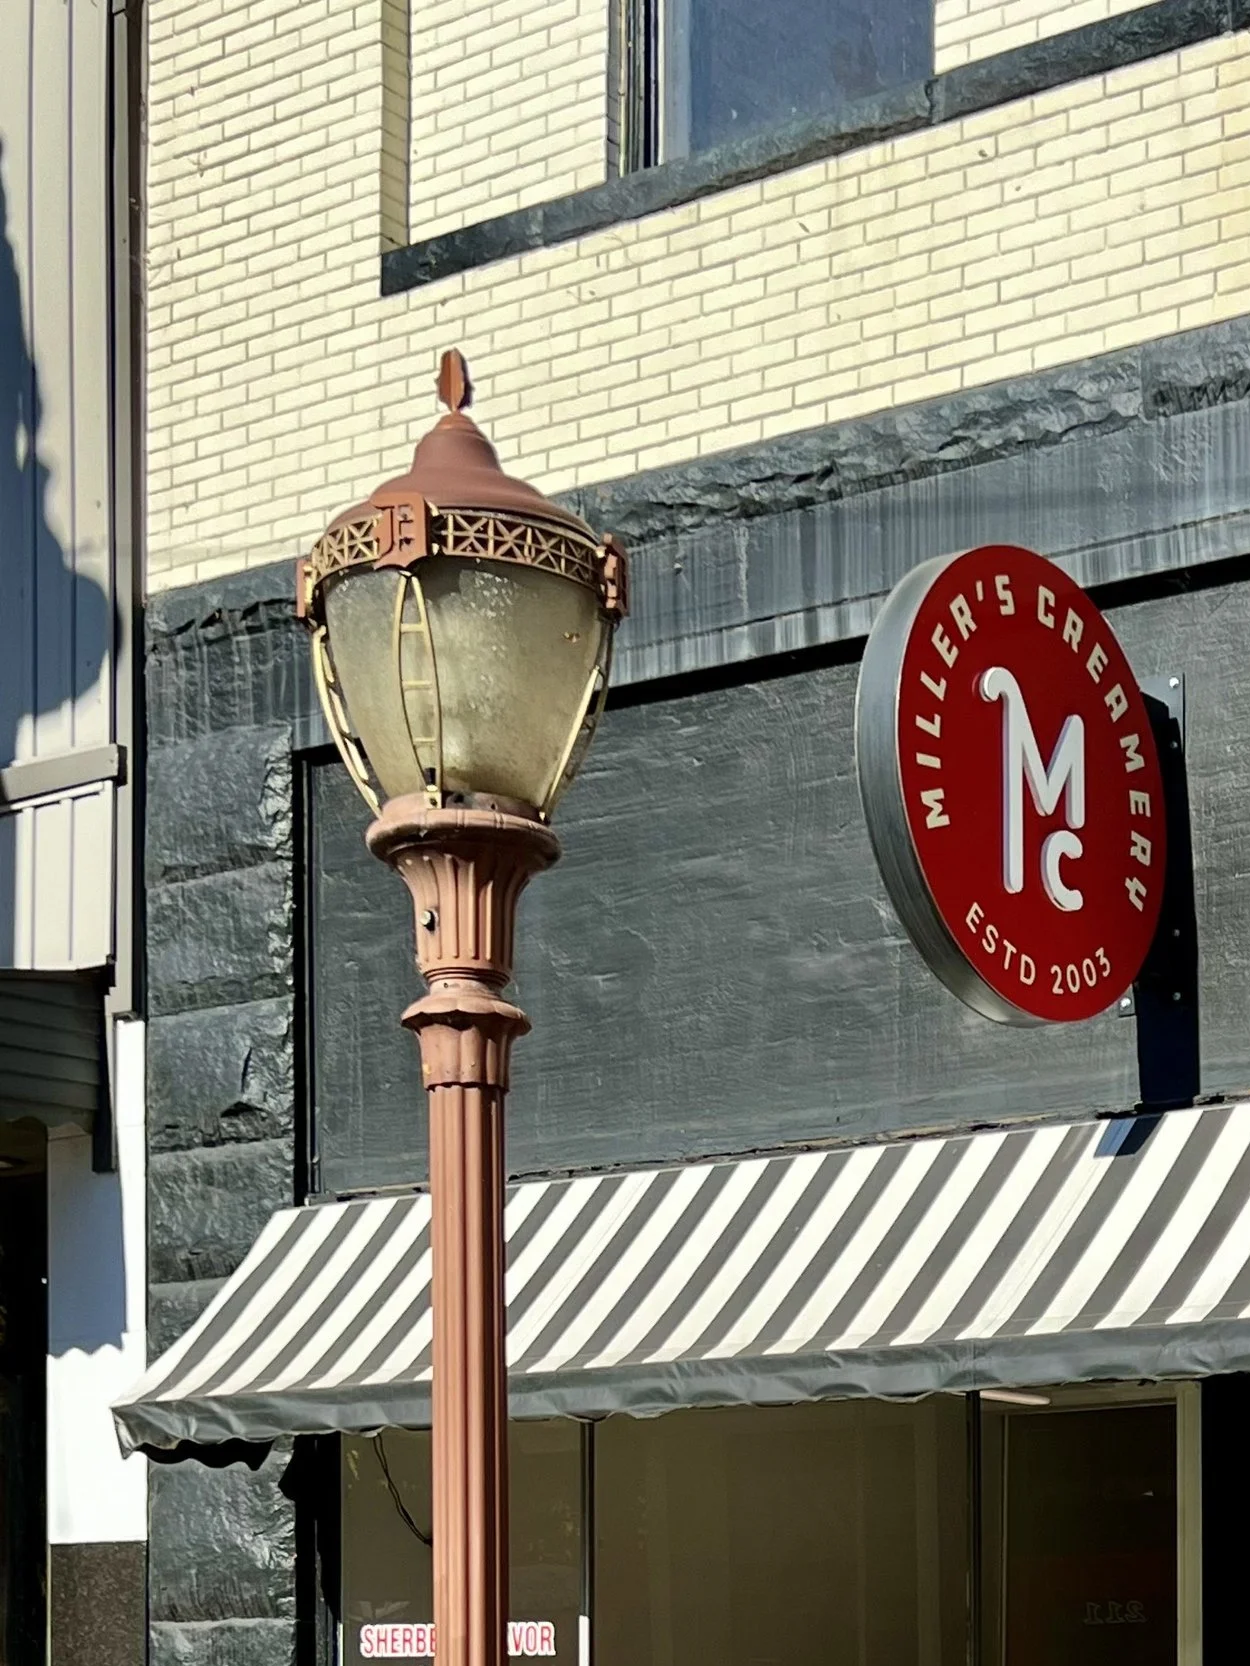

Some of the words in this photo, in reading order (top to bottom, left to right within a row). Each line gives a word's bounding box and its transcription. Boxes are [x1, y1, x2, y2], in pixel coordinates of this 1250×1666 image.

[916, 574, 1015, 830] MILLER'S
[1037, 585, 1152, 912] CREAMERY
[965, 902, 1036, 986] ESTD
[1050, 947, 1111, 995] 2003
[360, 1623, 436, 1658] SHERBE
[507, 1622, 556, 1656] VOR
